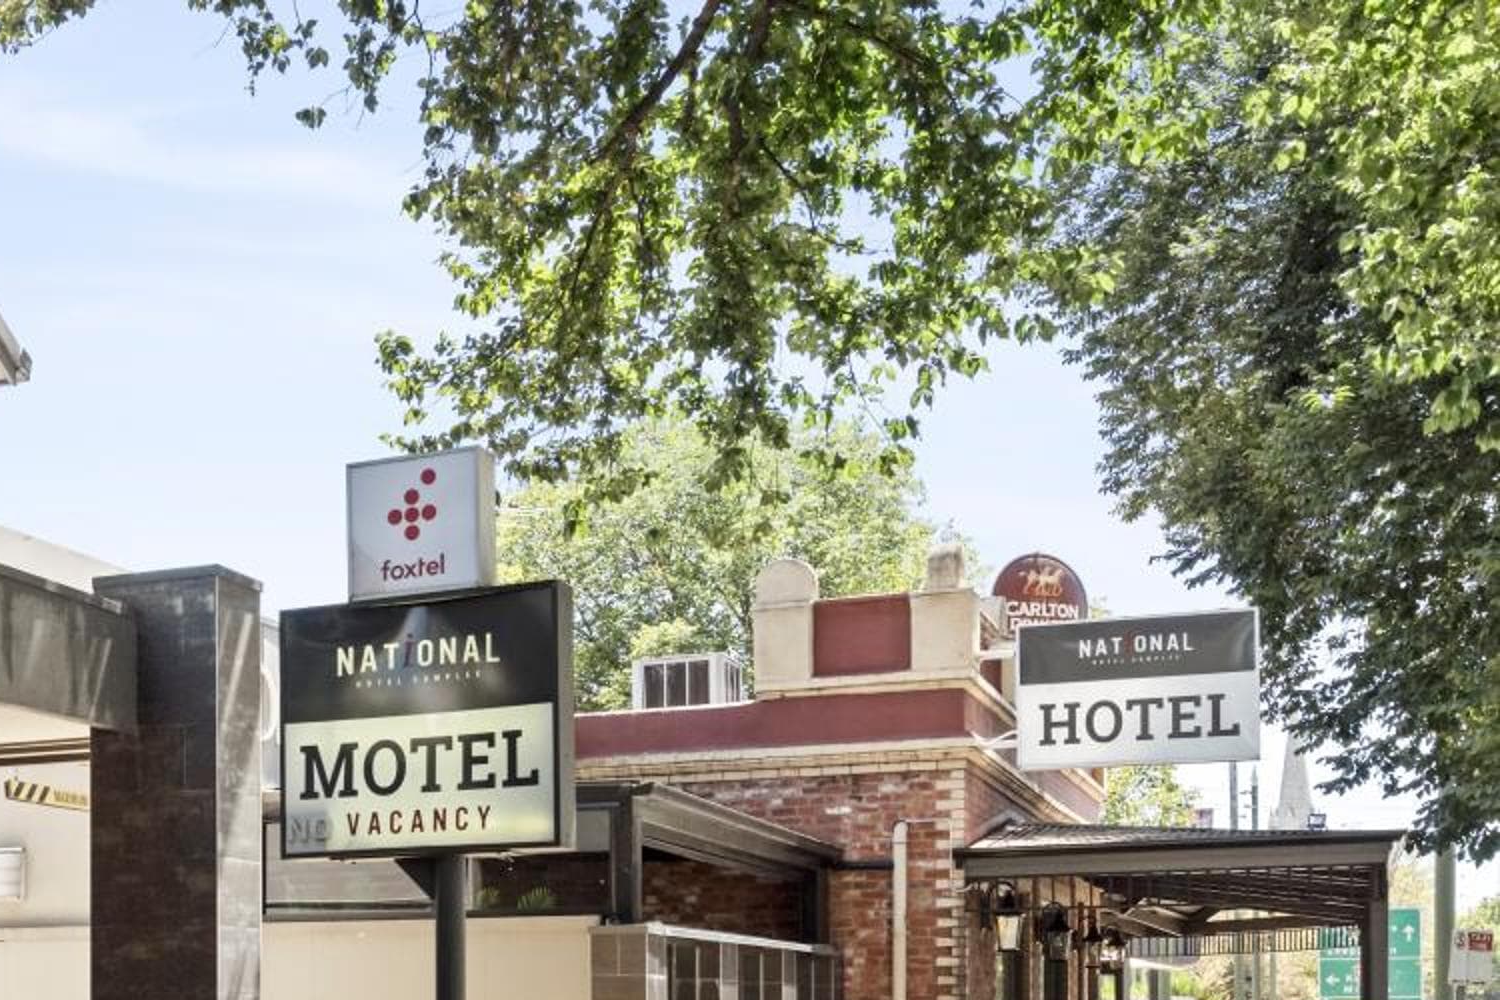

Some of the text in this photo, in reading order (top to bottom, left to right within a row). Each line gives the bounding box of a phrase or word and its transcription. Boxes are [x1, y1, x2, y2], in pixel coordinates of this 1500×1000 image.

[380, 552, 446, 582] foxtel
[1005, 601, 1079, 620] CARLTON
[1038, 693, 1241, 747] HOTEL
[299, 729, 540, 800] MOTEL
[347, 805, 492, 836] VACANCY
